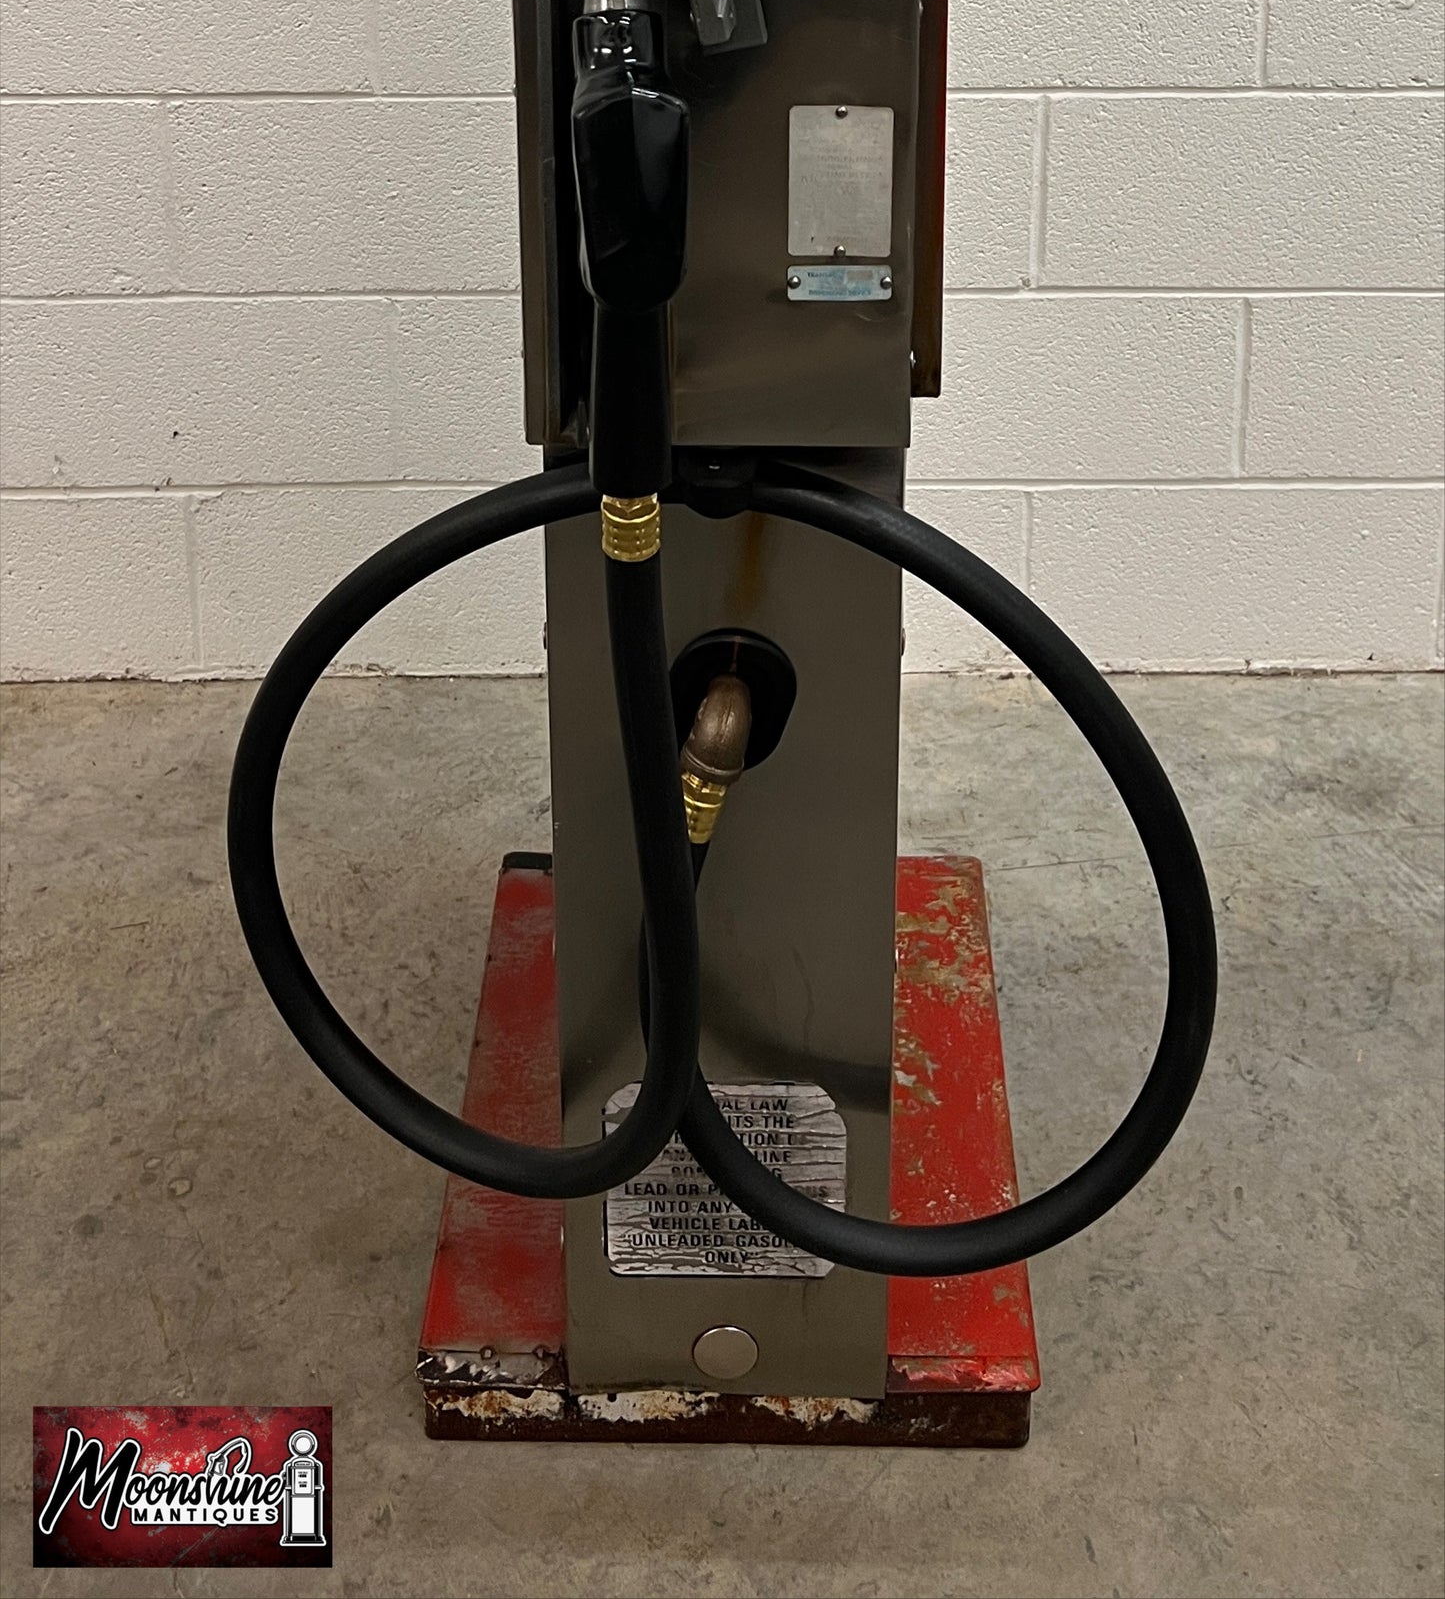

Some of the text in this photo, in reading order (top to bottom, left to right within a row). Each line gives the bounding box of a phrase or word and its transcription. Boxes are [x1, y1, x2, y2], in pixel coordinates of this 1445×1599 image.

[750, 1098, 789, 1111] LAW
[762, 1115, 794, 1129] THE
[624, 1183, 668, 1197] LEAD
[675, 1183, 700, 1196] OR
[648, 1200, 733, 1214] INTO ANY
[649, 1217, 721, 1232] VEHICLE
